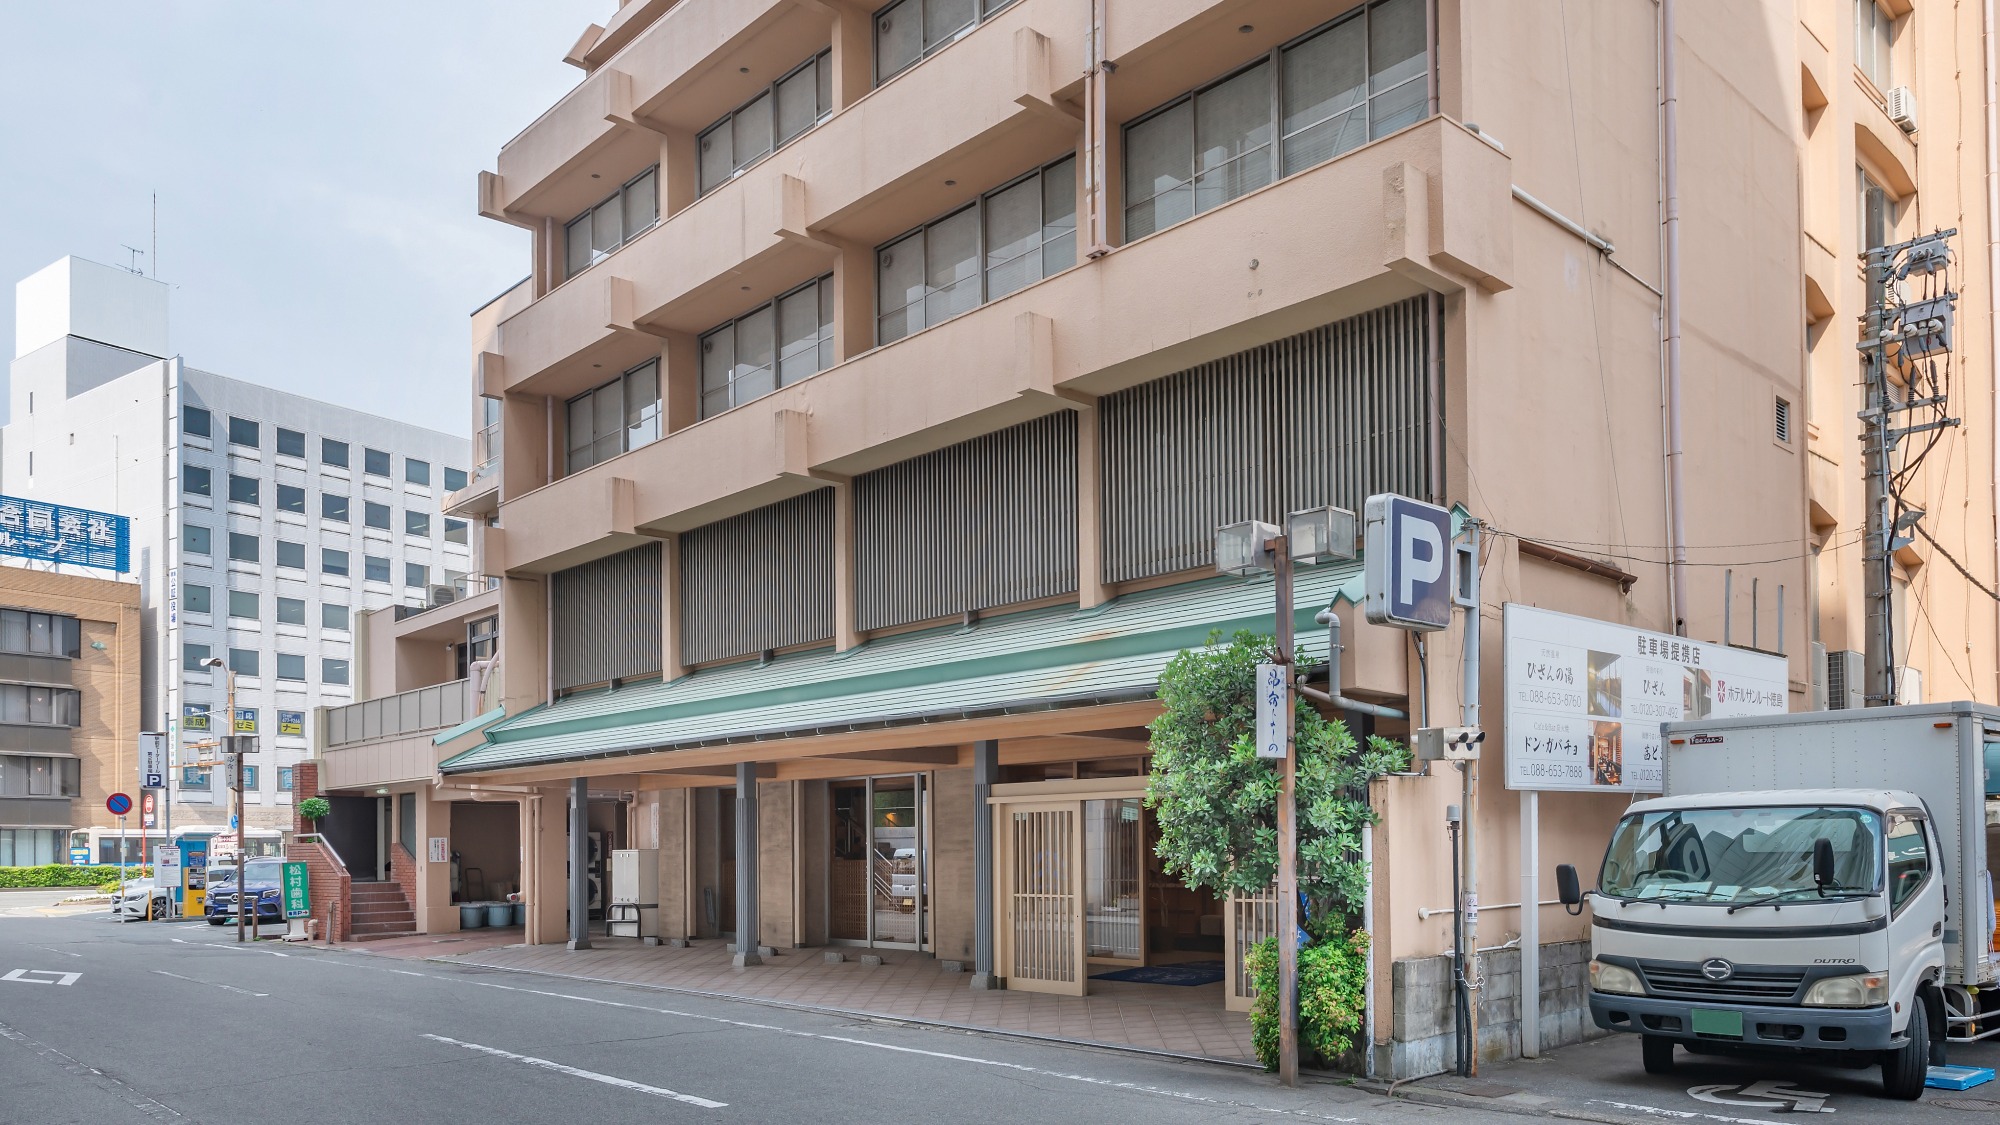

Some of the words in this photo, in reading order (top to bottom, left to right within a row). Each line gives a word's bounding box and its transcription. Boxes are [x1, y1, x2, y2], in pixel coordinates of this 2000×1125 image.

[0, 504, 110, 540] 合同会社
[1400, 513, 1444, 606] P
[1637, 635, 1701, 665] 駐車場提携店
[1529, 689, 1582, 708] 088-653-8760
[1728, 686, 1784, 709] ホテルサンルート徳島
[235, 720, 253, 730] ゼミ
[283, 724, 301, 732] ナー
[149, 775, 160, 786] P
[1530, 763, 1583, 779] 088-653-7888
[289, 865, 303, 909] 松村歯科
